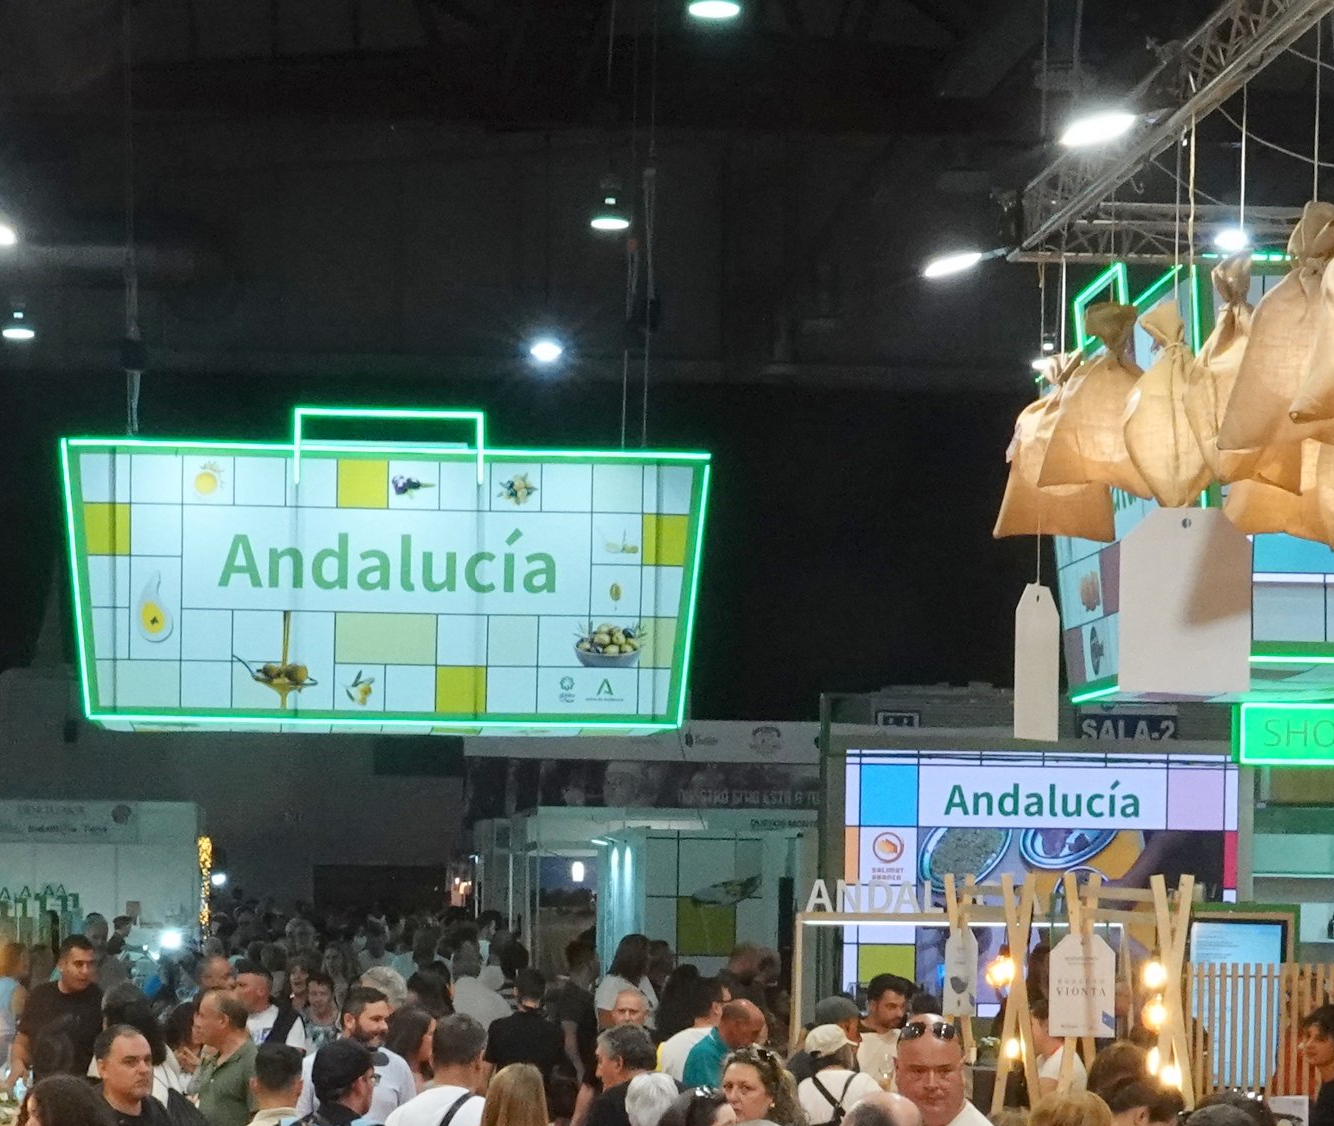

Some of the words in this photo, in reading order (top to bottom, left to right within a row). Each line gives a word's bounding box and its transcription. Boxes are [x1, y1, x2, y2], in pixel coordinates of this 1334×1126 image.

[217, 529, 558, 594] Andalucía
[1080, 718, 1176, 741] SALA-2
[943, 779, 1141, 818] Andalucía
[1055, 986, 1107, 997] VIONTA
